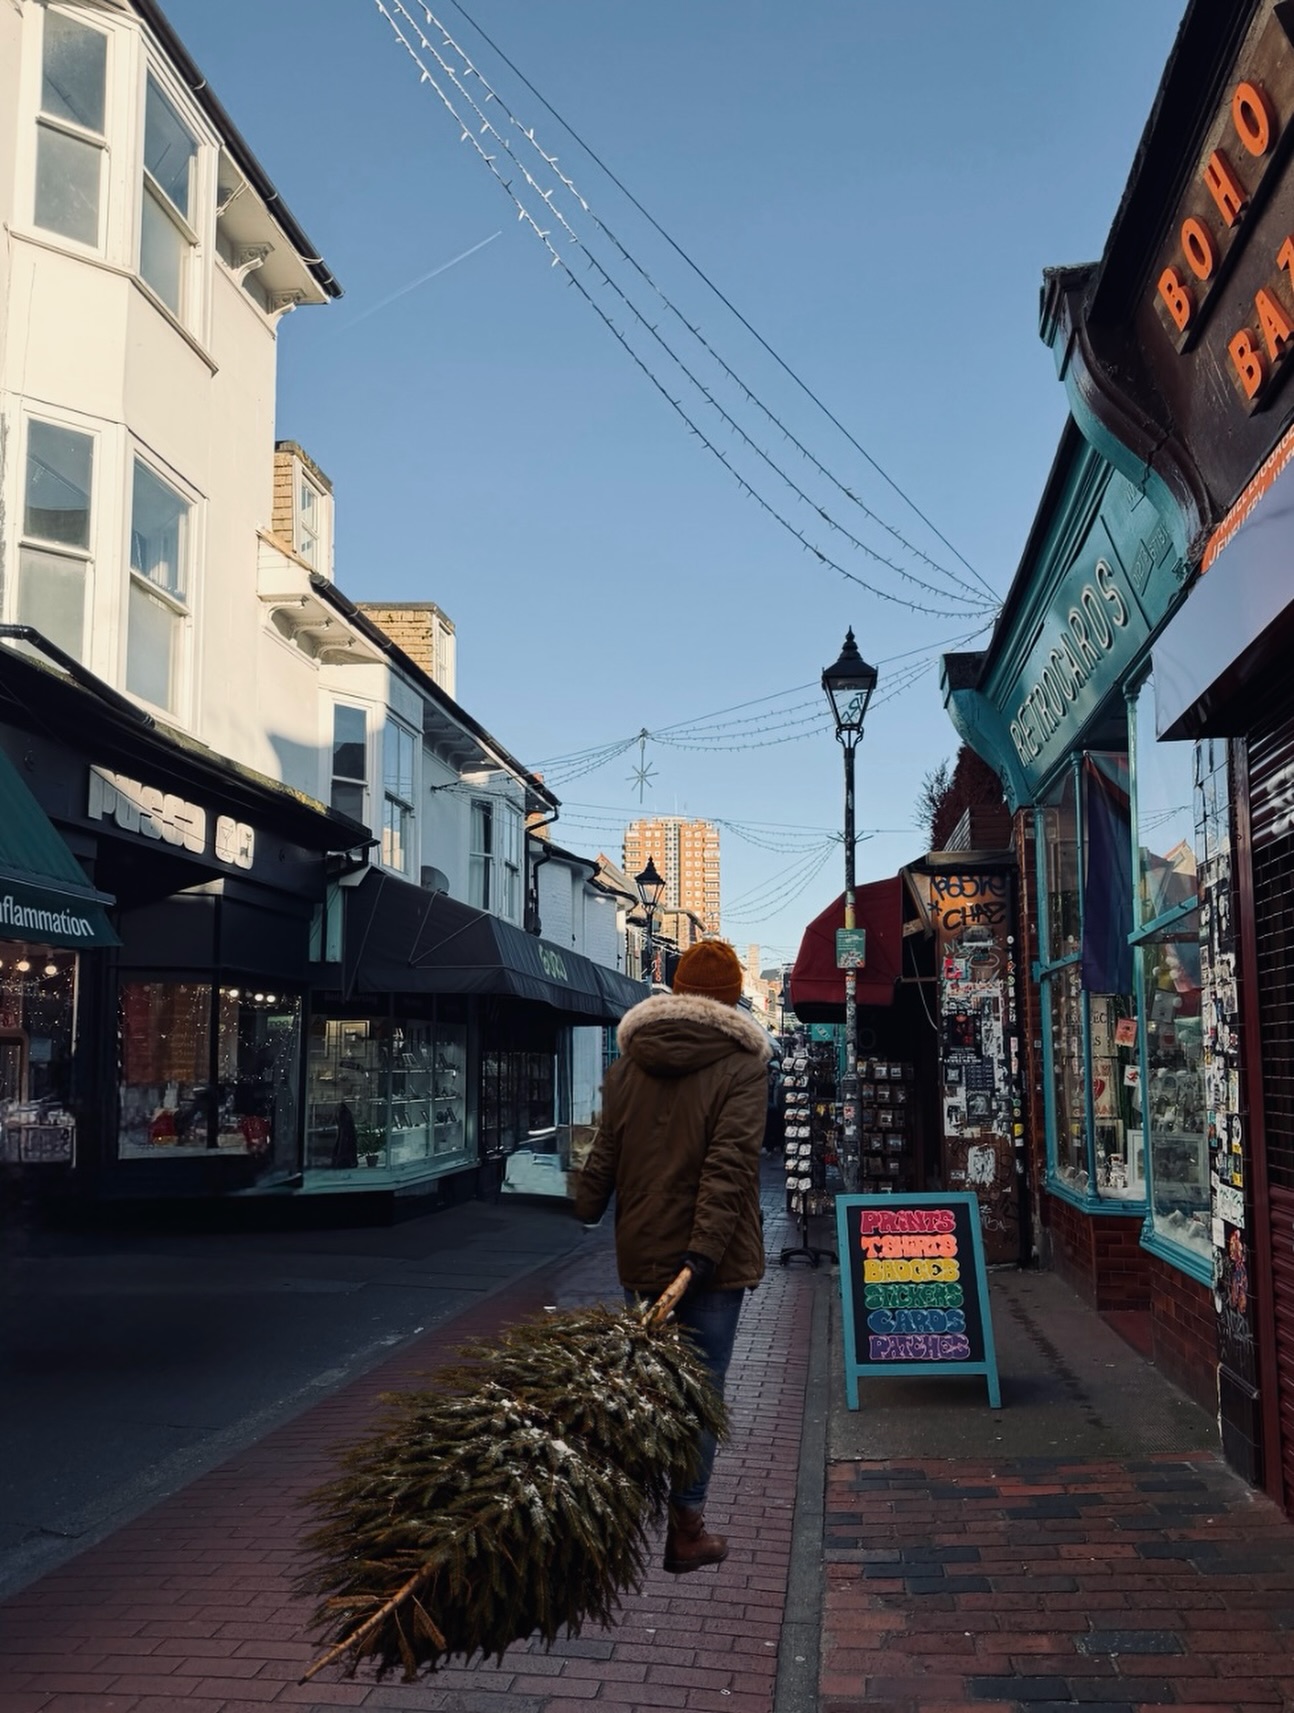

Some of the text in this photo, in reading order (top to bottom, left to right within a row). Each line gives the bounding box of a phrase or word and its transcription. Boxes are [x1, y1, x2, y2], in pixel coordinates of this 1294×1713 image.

[1157, 80, 1271, 333] BOHO
[1009, 557, 1132, 768] RETROCARDS
[864, 1258, 960, 1283] BADGES
[864, 1283, 964, 1309] STICKERS
[867, 1309, 966, 1334] CARDS
[869, 1334, 970, 1360] PATCHES
